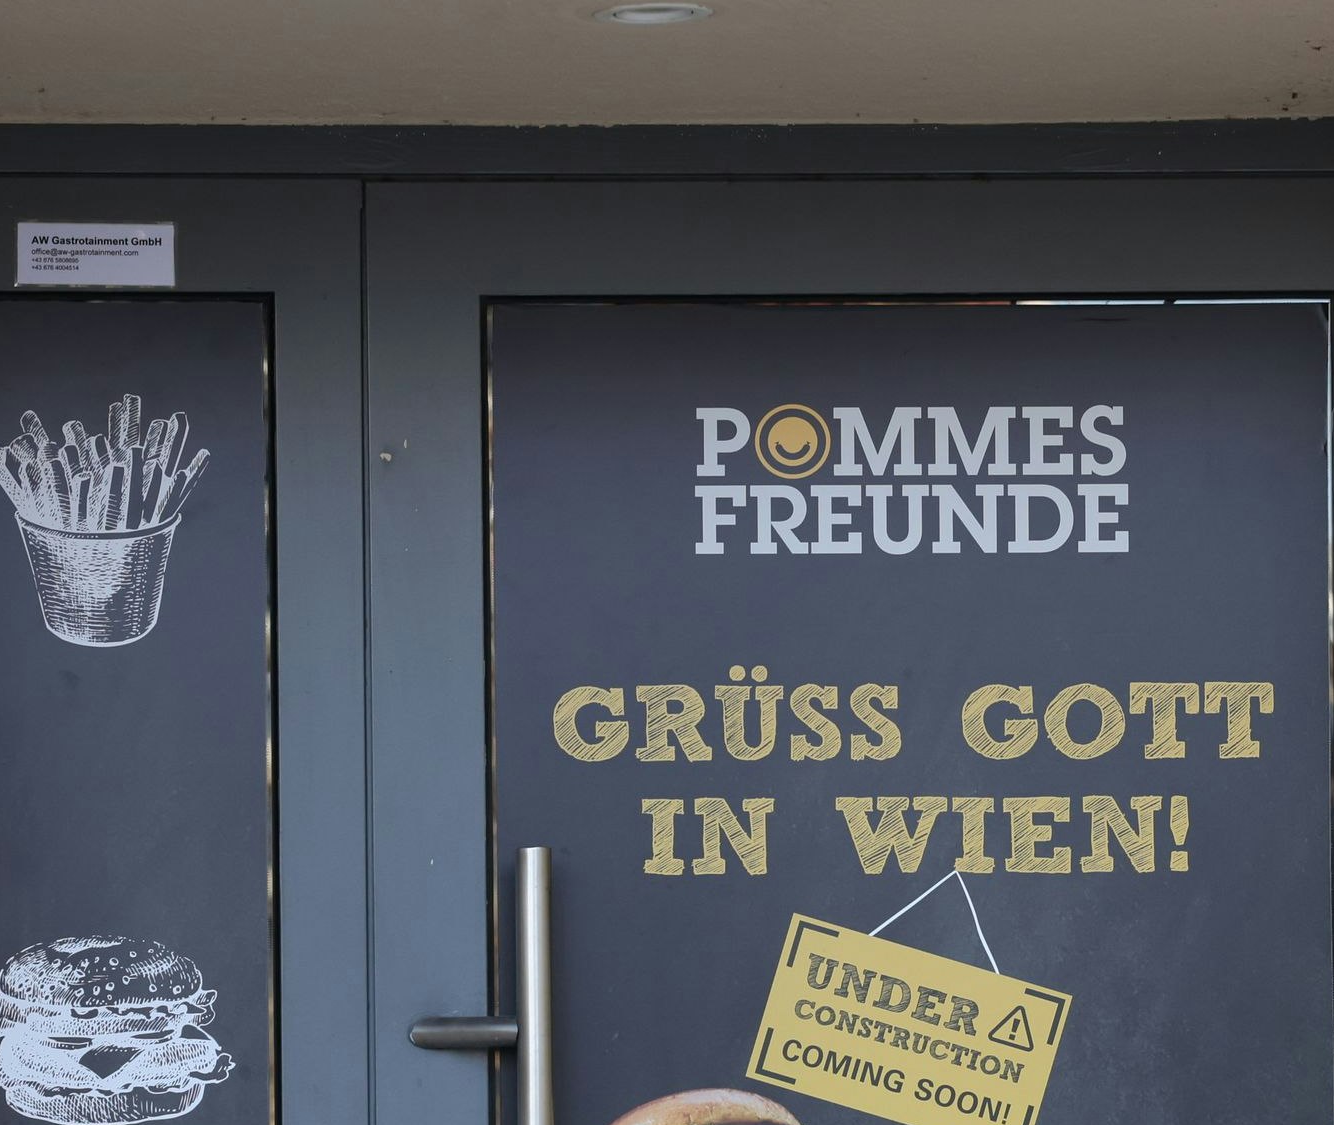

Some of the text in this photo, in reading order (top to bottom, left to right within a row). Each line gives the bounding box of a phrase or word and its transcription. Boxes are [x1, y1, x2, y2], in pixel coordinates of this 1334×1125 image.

[31, 236, 162, 246] AW Gastrotainment GmbH
[695, 404, 1126, 479] POMMES
[695, 484, 1130, 555] FREUNDE
[552, 665, 1274, 763] GRÜSS GOTT
[641, 796, 1190, 876] IN WIEN!
[806, 953, 980, 1036] UNDER
[794, 999, 1025, 1083] CONSTRUCTION
[782, 1039, 1012, 1125] COMING SOON!
